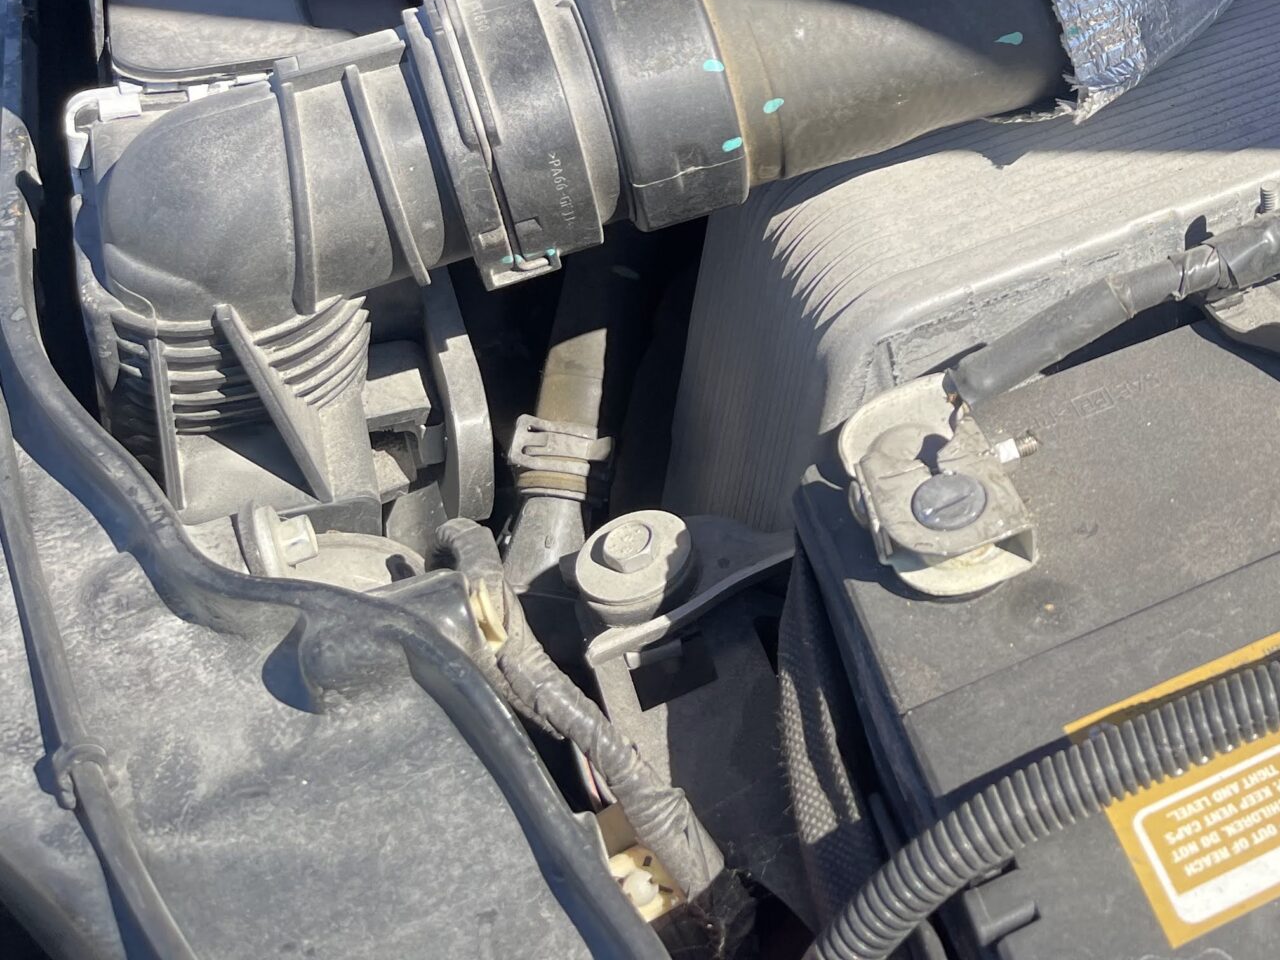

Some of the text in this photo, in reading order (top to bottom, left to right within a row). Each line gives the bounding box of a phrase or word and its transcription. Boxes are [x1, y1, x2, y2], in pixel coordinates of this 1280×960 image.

[1163, 760, 1280, 826] TIGHT AND LEVEL.
[1235, 783, 1273, 811] KEEP
[1200, 800, 1239, 828] VENT
[1162, 816, 1203, 846] CAPS
[1197, 828, 1221, 849] DO
[1227, 835, 1250, 855] OF
[1247, 821, 1279, 846] OUT
[1168, 839, 1200, 863] NOT
[1181, 843, 1231, 878] REACH
